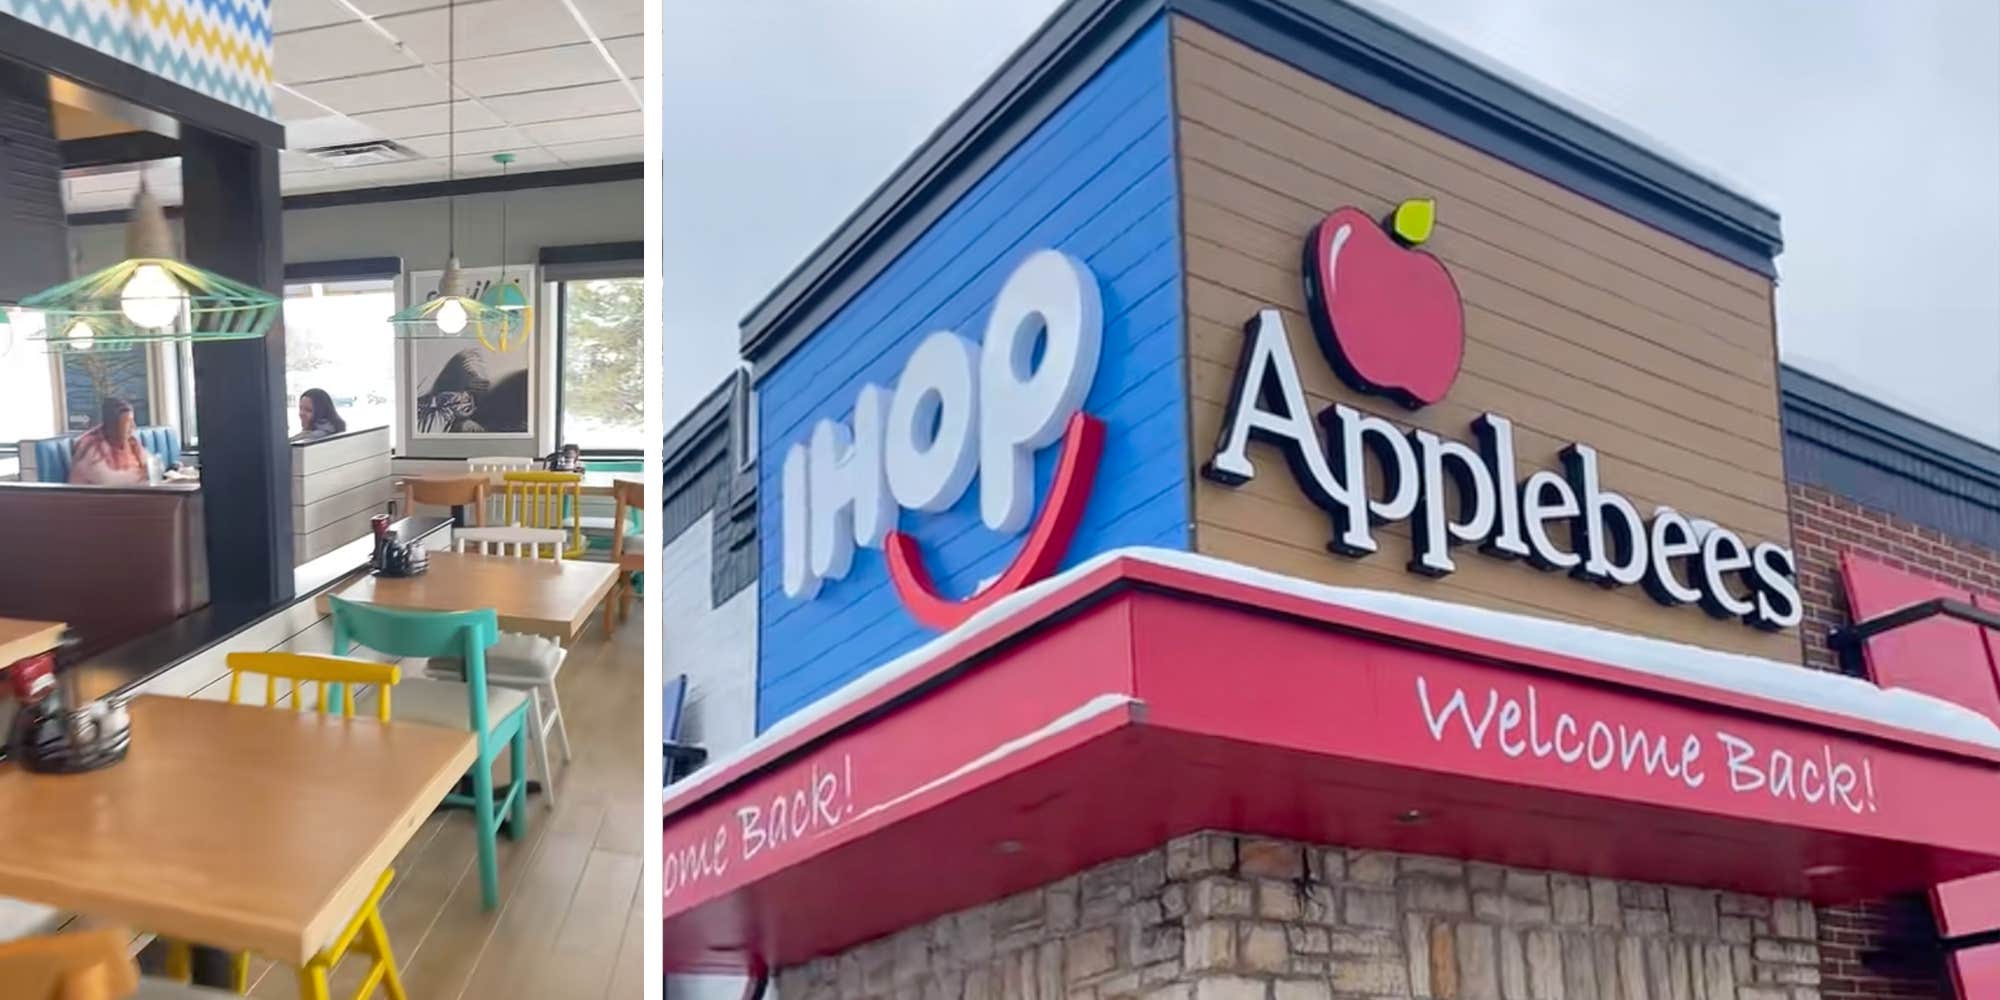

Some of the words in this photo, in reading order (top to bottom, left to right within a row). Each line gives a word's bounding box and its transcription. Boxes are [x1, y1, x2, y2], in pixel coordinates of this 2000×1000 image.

[782, 249, 1104, 601] IHOP
[1202, 309, 1803, 632] Applebees
[735, 753, 853, 861] Back!
[1416, 676, 1704, 787] Welcome
[1716, 730, 1877, 814] Back!
